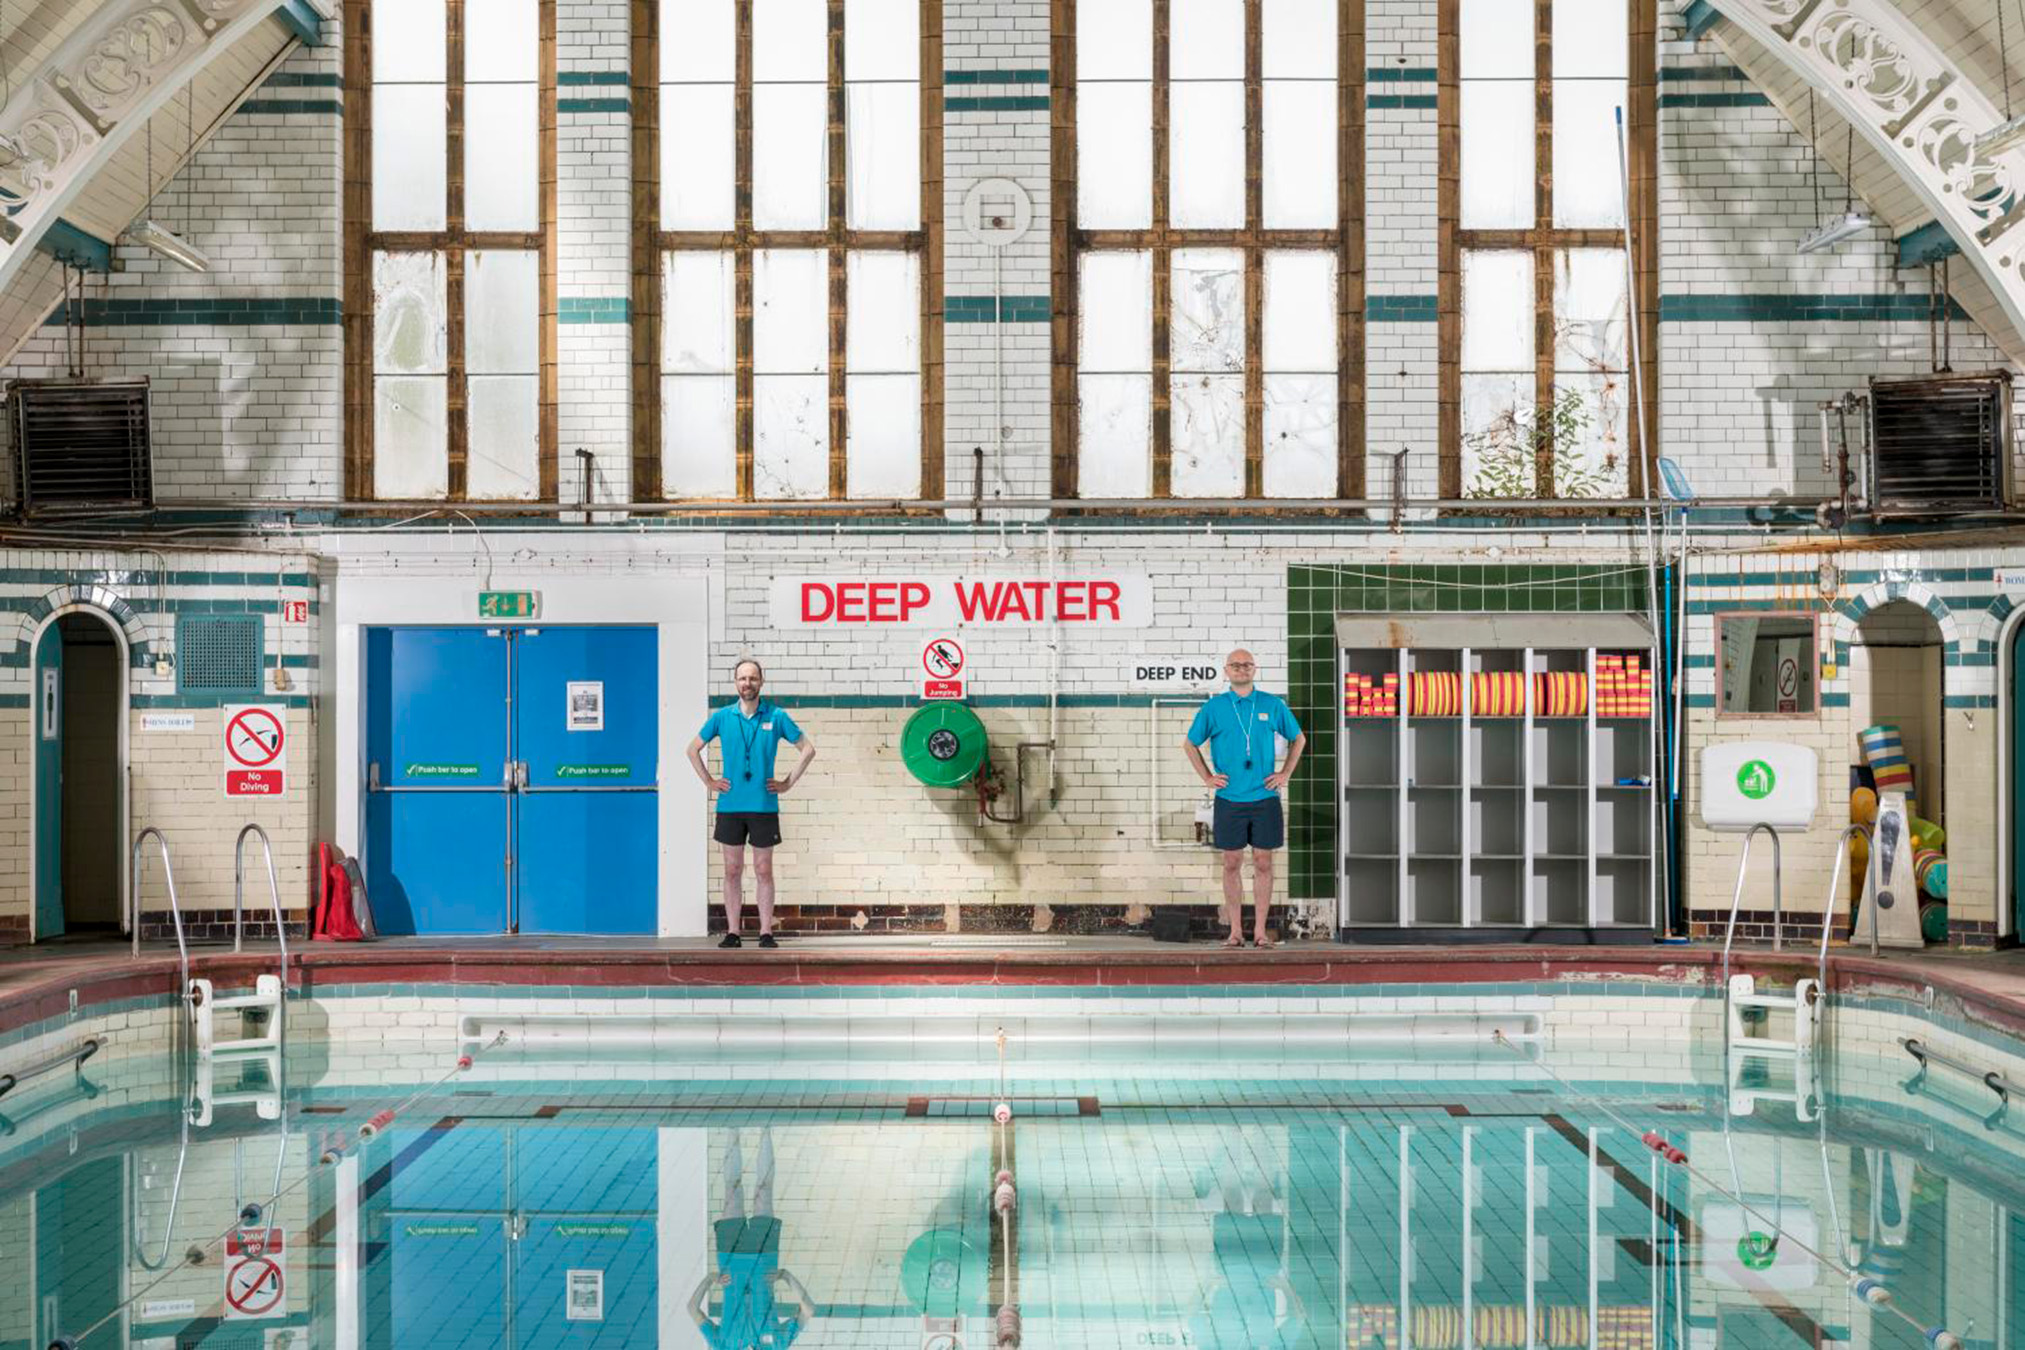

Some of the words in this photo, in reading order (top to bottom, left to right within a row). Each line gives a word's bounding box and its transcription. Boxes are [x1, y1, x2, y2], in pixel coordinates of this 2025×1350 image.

[801, 582, 931, 622] DEEP
[953, 582, 1121, 621] WATER
[1136, 666, 1176, 681] DEEP
[1182, 666, 1217, 681] END
[929, 689, 959, 698] Jumping
[437, 766, 450, 774] bar
[459, 767, 478, 775] open
[610, 767, 629, 775] open
[248, 772, 262, 781] No
[240, 782, 270, 793] Diving
